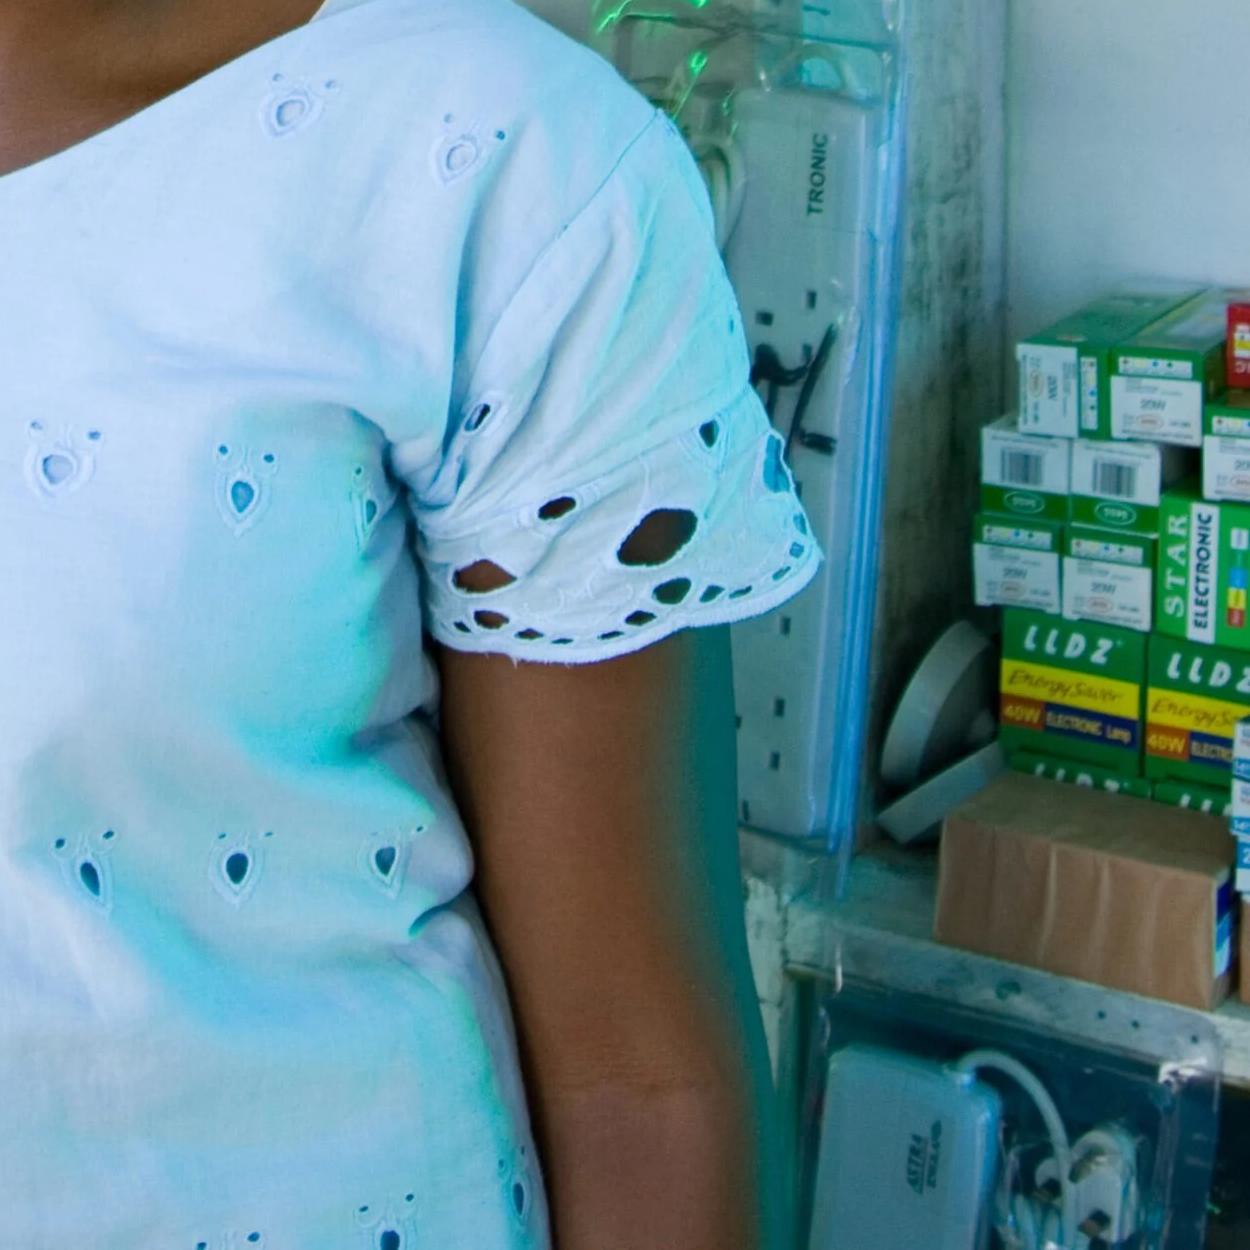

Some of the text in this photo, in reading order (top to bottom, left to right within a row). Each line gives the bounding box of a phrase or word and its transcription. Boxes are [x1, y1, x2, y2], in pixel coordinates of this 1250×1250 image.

[806, 133, 829, 217] TRONIC
[1164, 514, 1189, 619] STAR
[1193, 513, 1213, 630] ELECTRONIC
[1023, 625, 1115, 666] LLDZ
